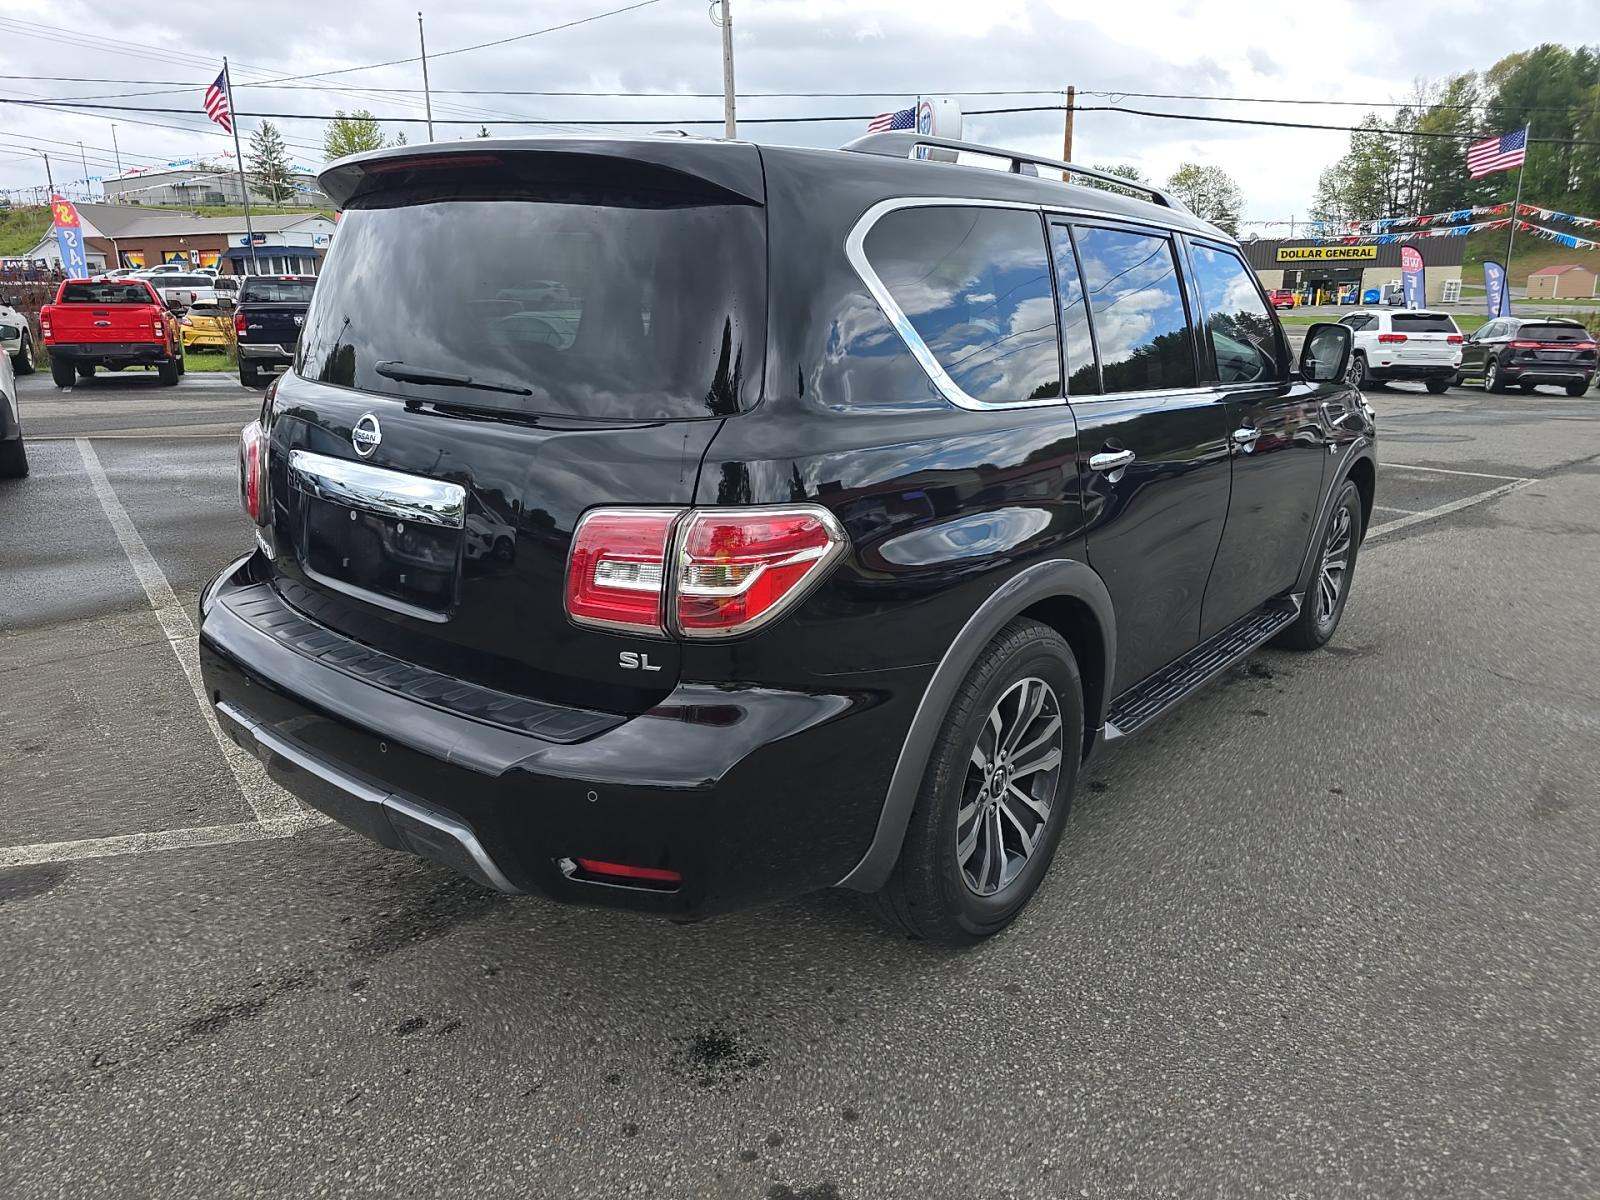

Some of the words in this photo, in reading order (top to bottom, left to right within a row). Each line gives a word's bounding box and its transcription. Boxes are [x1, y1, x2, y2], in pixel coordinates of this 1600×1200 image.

[1281, 250, 1322, 258] DOLLAR
[1325, 248, 1373, 257] GENERAL
[619, 651, 662, 671] SL
